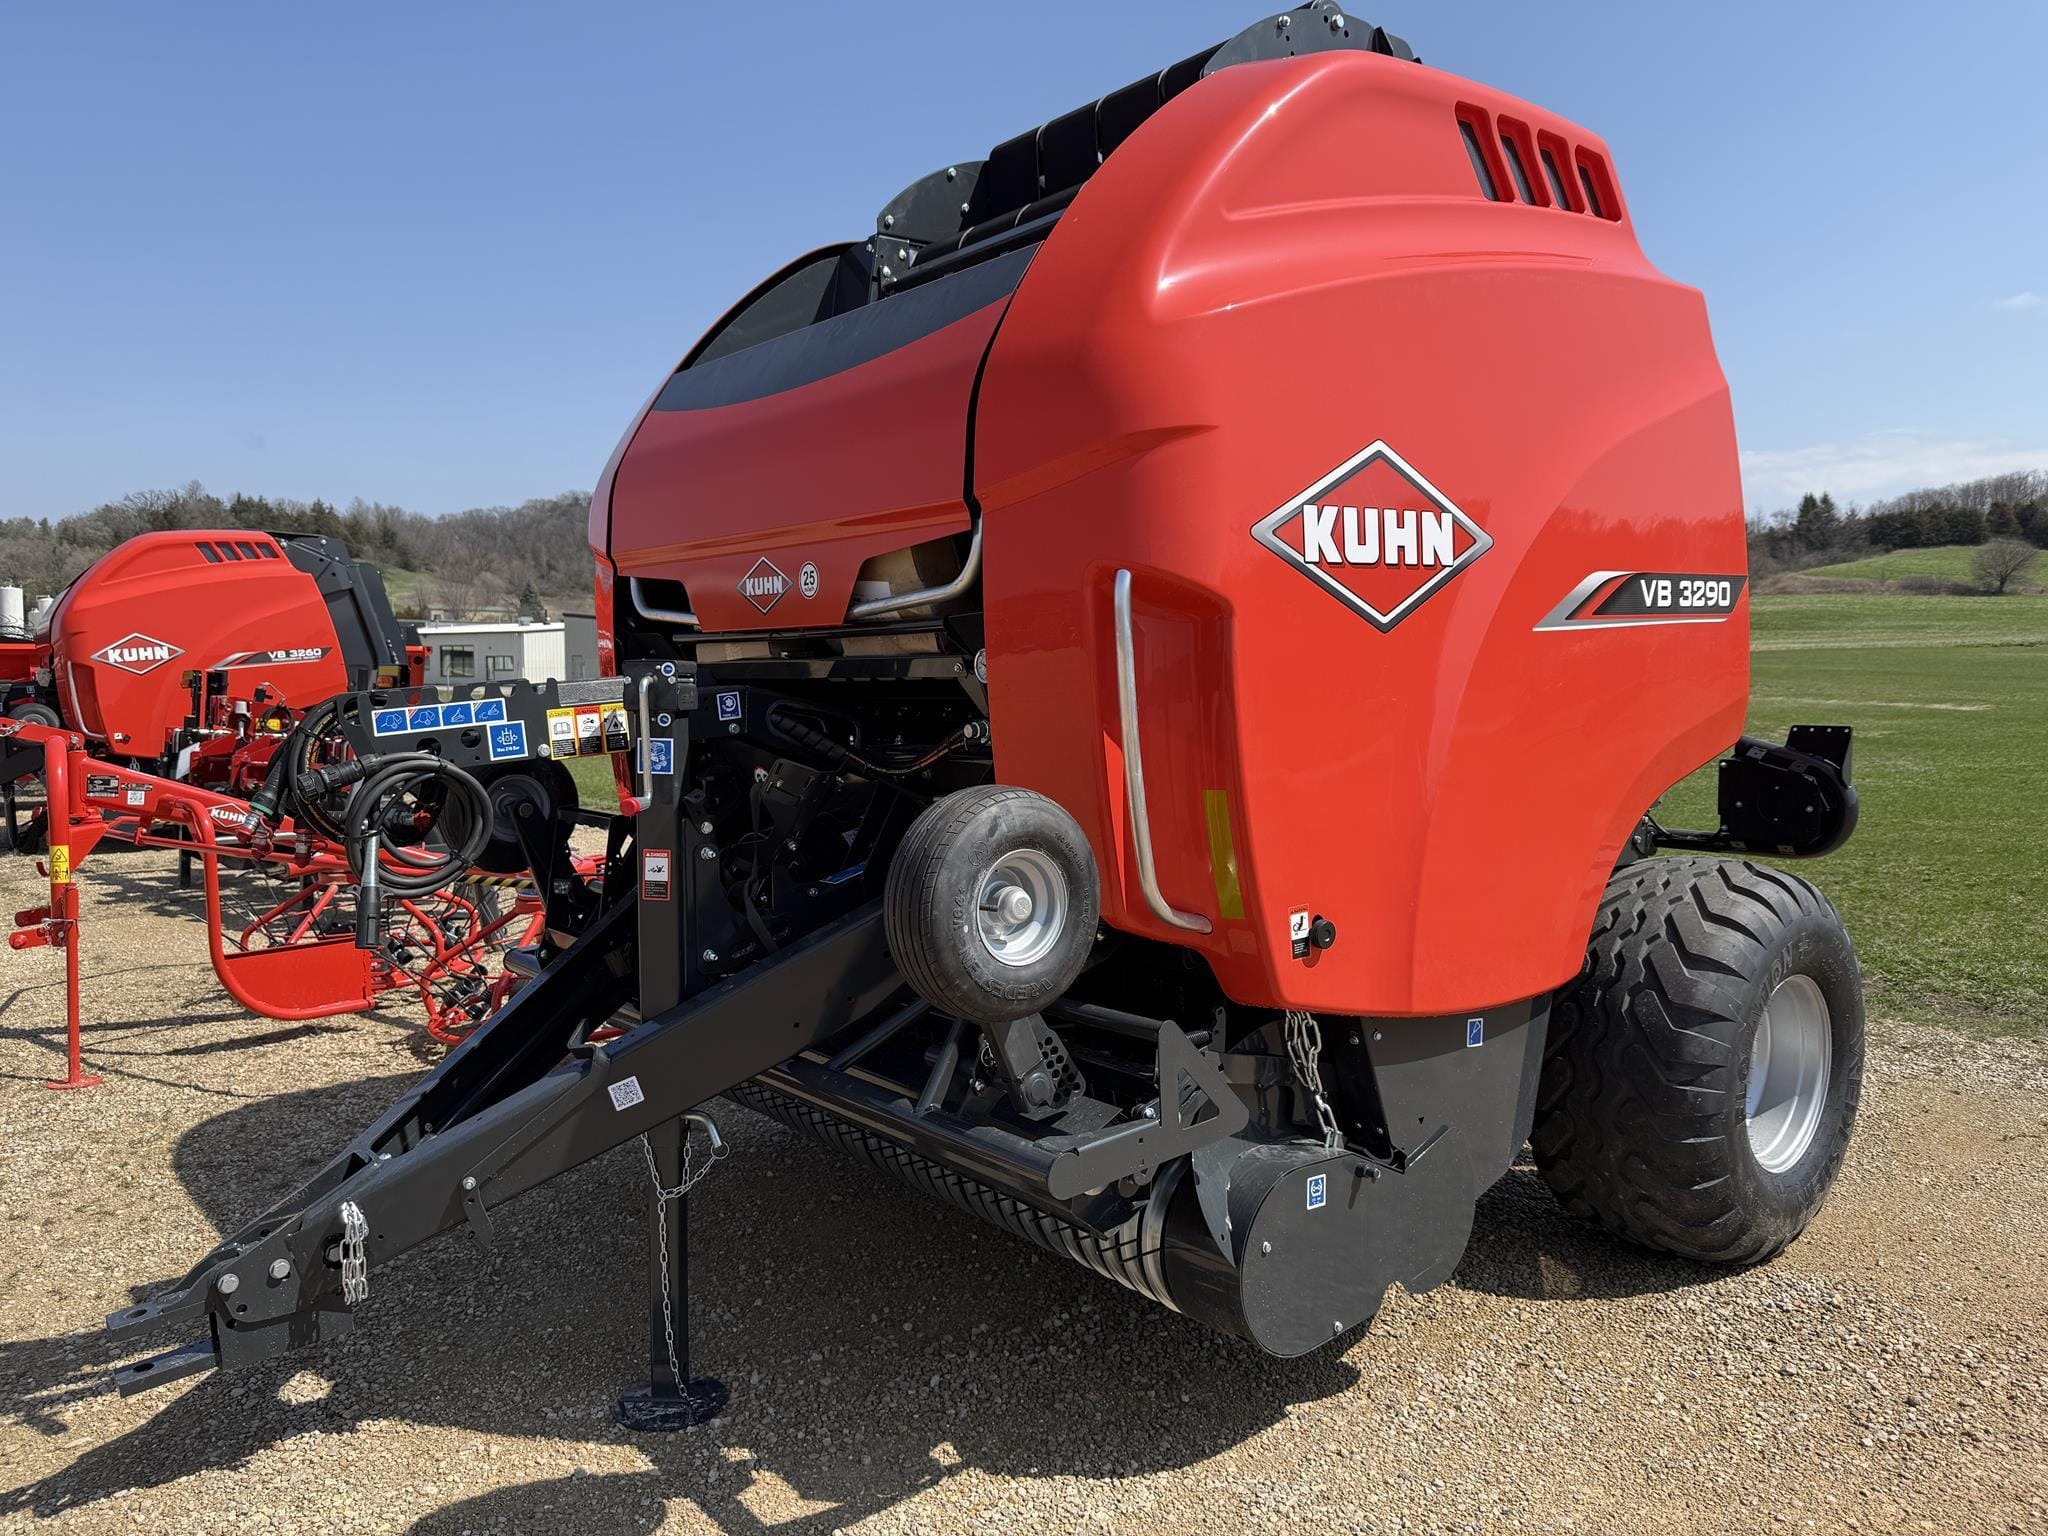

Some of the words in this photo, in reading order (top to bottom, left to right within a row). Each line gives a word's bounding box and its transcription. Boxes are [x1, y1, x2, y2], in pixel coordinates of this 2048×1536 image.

[1302, 504, 1455, 568] KUHN
[746, 575, 783, 597] KUHN
[803, 570, 815, 586] 25
[1640, 579, 1672, 608] VB
[1679, 579, 1731, 608] 3290
[106, 646, 170, 664] KUHN
[267, 650, 286, 659] VB
[289, 648, 322, 658] 3260
[210, 808, 247, 824] KUHN
